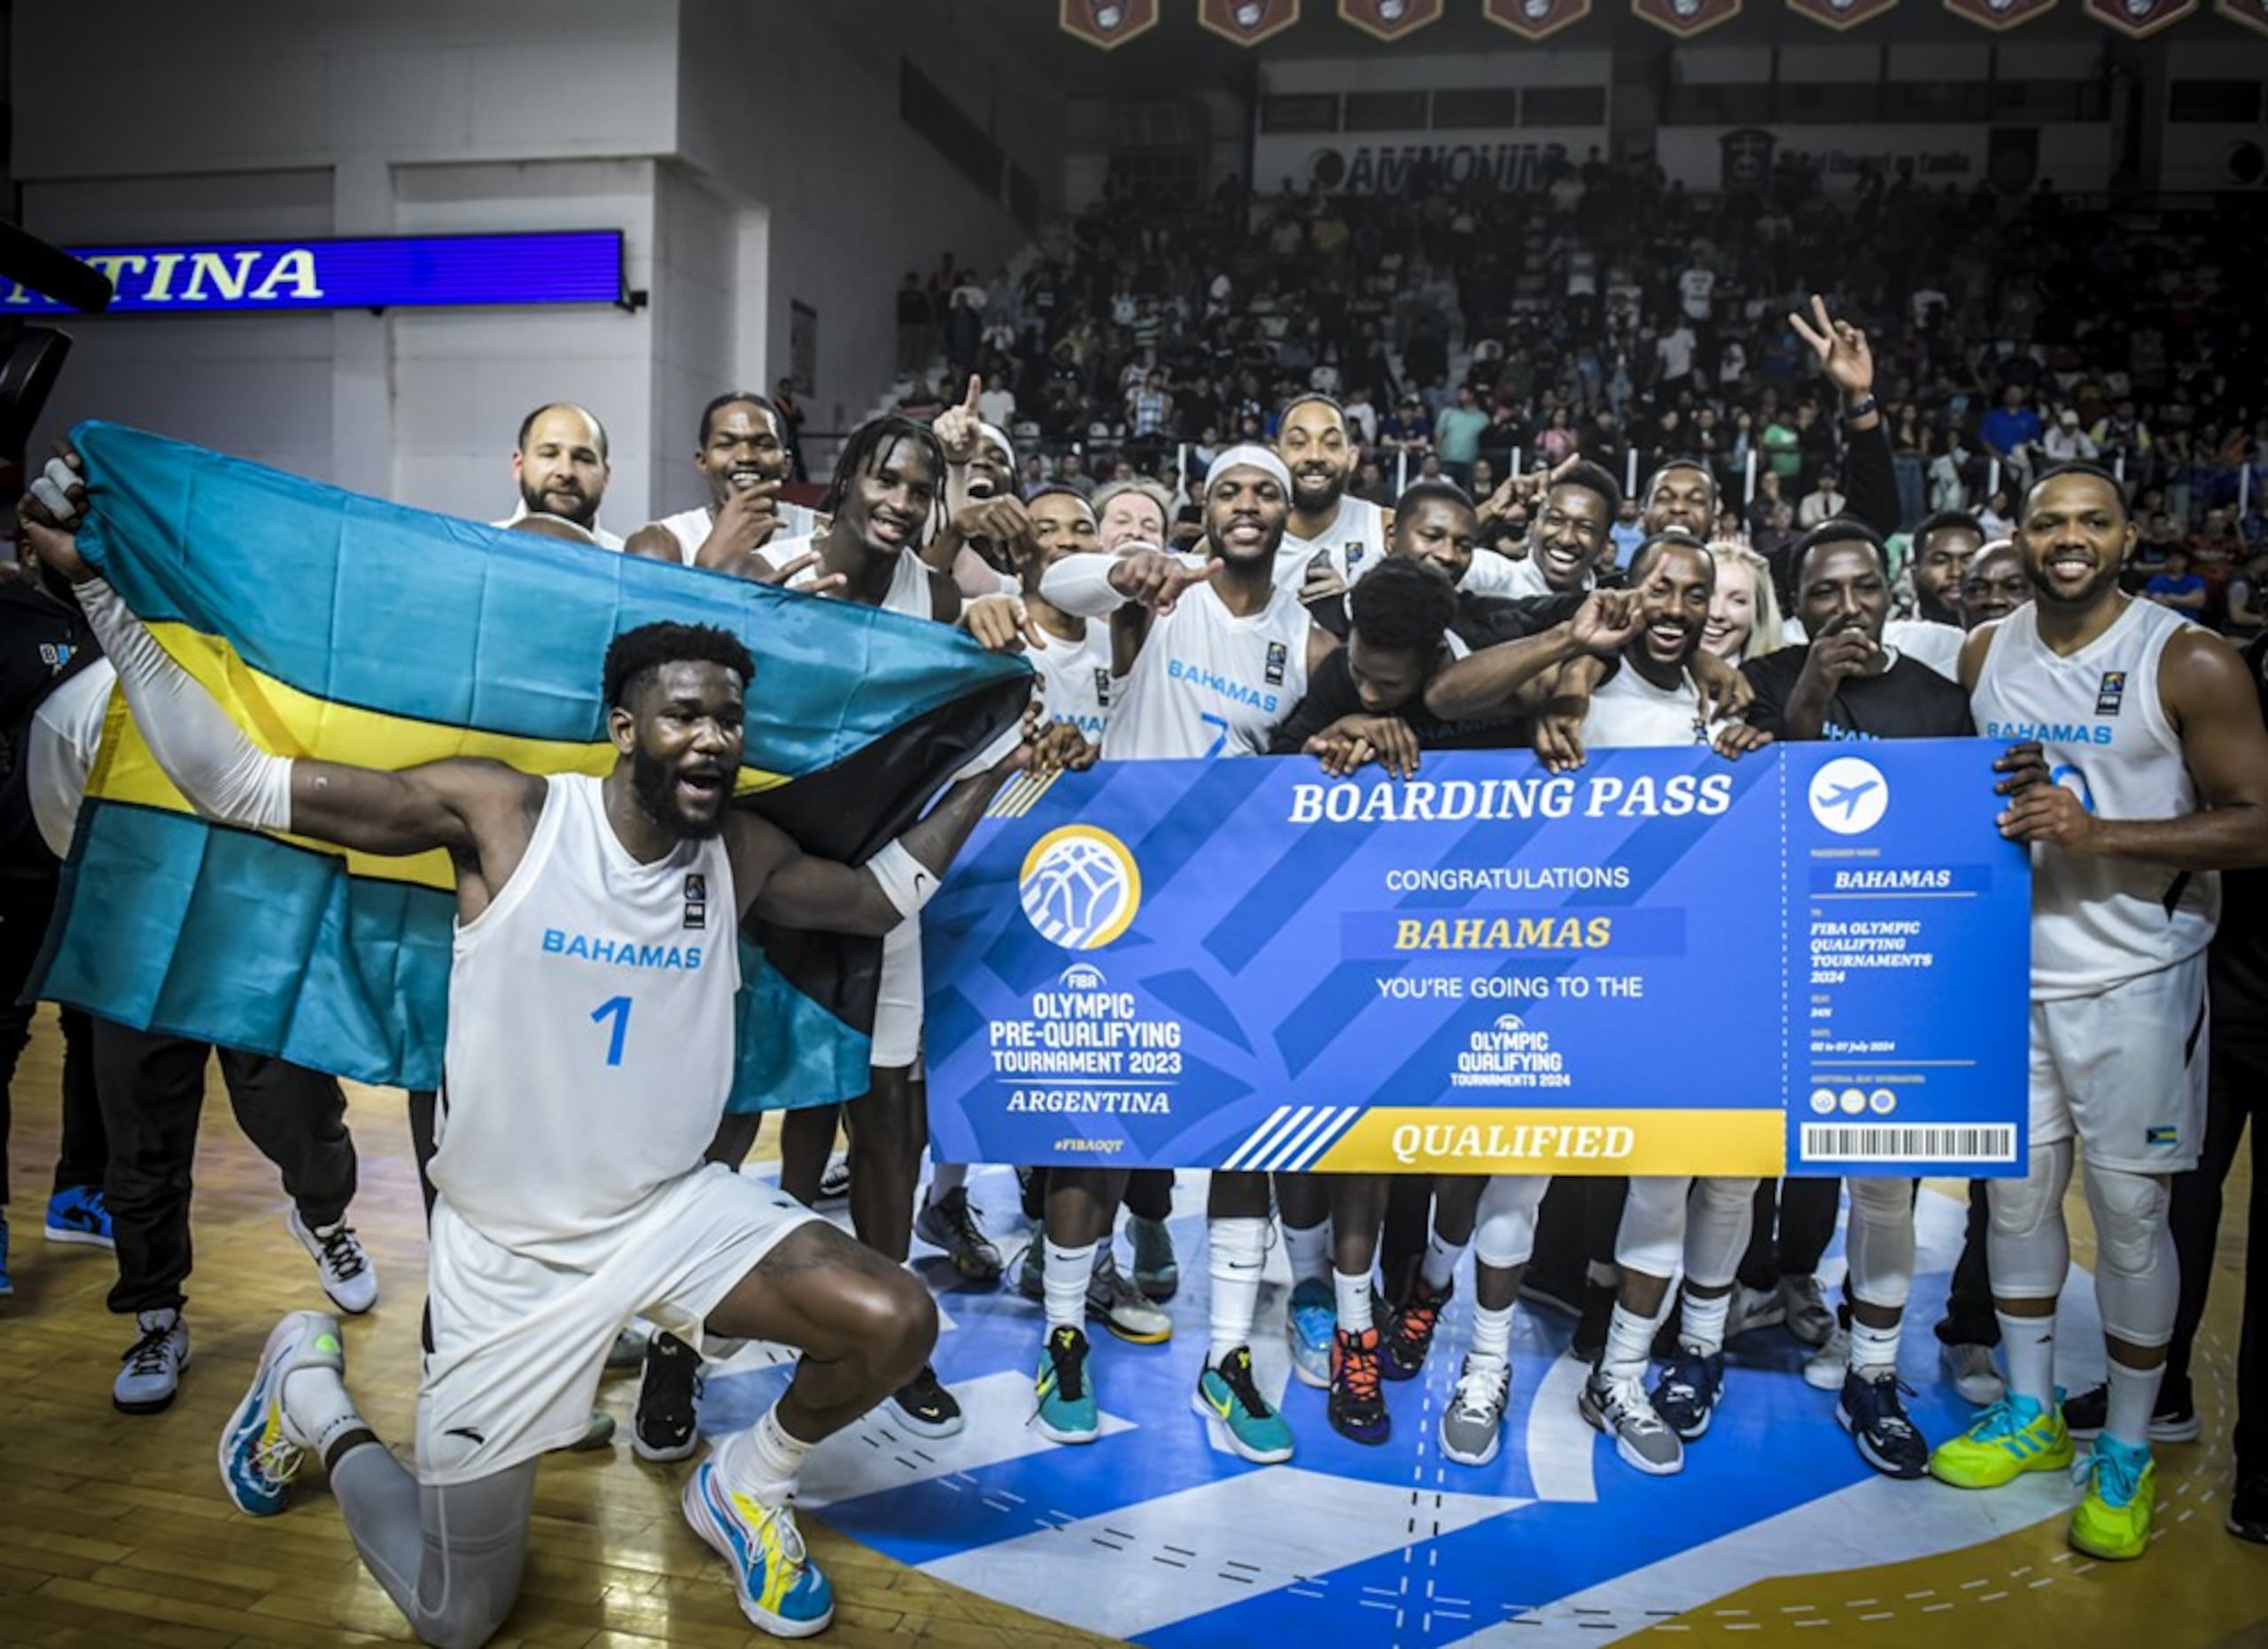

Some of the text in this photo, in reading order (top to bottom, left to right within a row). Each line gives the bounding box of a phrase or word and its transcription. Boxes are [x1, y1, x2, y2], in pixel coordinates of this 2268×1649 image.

[4, 249, 323, 302] TINA
[1167, 659, 1278, 712] BAHAMAS
[1200, 712, 1228, 760] 7
[1986, 722, 2113, 744] BAHAMAS
[1287, 774, 1732, 823] BOARDING PASS
[1386, 867, 1630, 891] CONGRATULATIONS
[1834, 869, 1951, 889] BAHAMAS
[1394, 916, 1612, 950] BAHAMAS
[1811, 922, 1921, 936] FIBA OLYMPIC
[541, 929, 703, 969] BAHAMAS
[1810, 937, 1906, 953] QUALIFYING
[1811, 953, 1932, 968] TOURNAMENTS
[1068, 974, 1098, 990] FIBA
[1377, 976, 1643, 999] YOU'RE GOING TO THE
[1810, 970, 1845, 984] 2024
[1033, 992, 1135, 1019] OLYMPIC
[590, 995, 633, 1067] 1
[990, 1021, 1181, 1048] PRE-QUALIFYING
[1471, 1031, 1549, 1052] OLYMPIC
[991, 1050, 1182, 1074] TOURNAMENT 2023
[1458, 1052, 1562, 1072] QUALIFYING
[1451, 1073, 1571, 1087] TOURNAMENTS 2024
[1006, 1090, 1170, 1114] ARGENTINA
[1392, 1124, 1635, 1163] QUALIFIED
